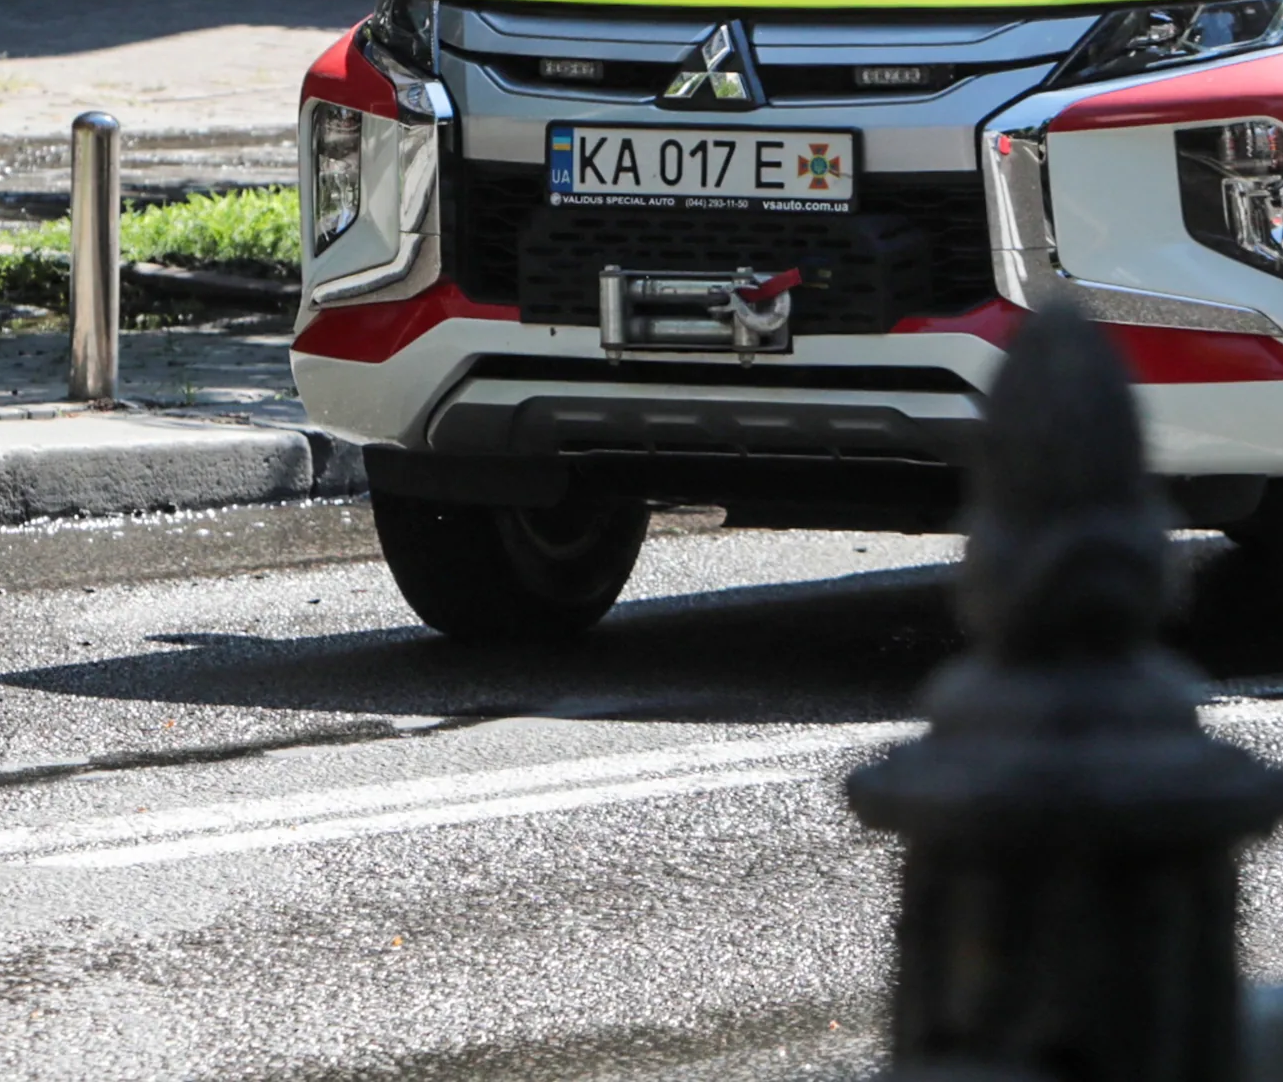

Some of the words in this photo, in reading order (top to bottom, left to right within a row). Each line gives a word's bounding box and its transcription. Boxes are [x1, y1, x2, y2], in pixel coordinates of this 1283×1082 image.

[579, 136, 641, 186] KA
[660, 139, 736, 188] 017
[755, 141, 785, 189] E
[551, 169, 570, 184] UA
[562, 195, 603, 205] VALIDUS
[606, 197, 646, 206] SPECIAL
[648, 198, 675, 207] AUTO
[685, 198, 707, 209] (044)
[762, 199, 849, 212] vsauto.com.ua
